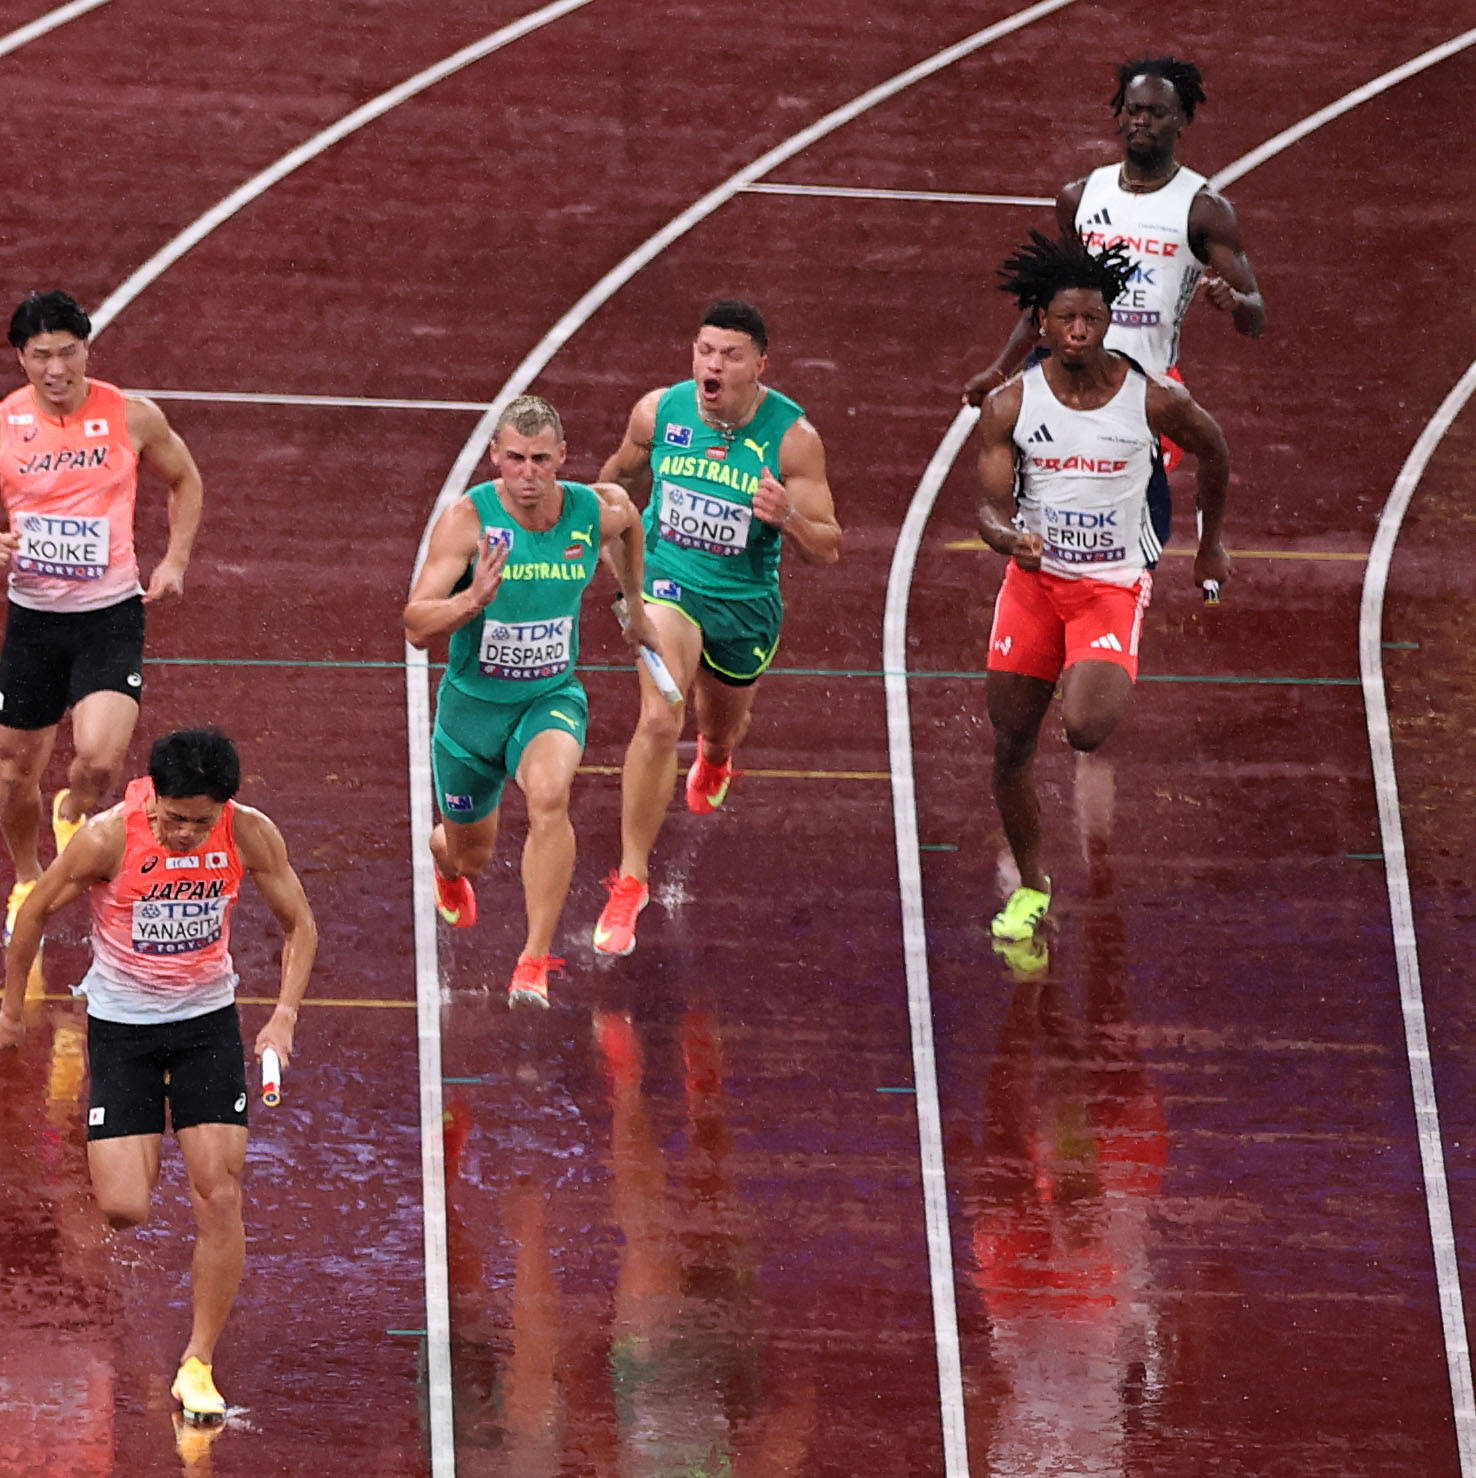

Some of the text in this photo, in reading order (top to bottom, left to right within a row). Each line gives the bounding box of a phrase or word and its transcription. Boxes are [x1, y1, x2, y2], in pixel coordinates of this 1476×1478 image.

[19, 447, 107, 474] JAPAN
[1033, 456, 1128, 473] FRANCE
[659, 456, 760, 494] AUSTRALIA
[686, 493, 744, 522] TDK
[41, 518, 100, 537] TDK
[670, 509, 736, 542] BOND
[1058, 510, 1117, 528] TDK
[1047, 526, 1114, 549] ERIUS
[27, 538, 97, 562] KOIKE
[502, 562, 586, 580] AUSTRALIA
[511, 621, 563, 641] TDK
[486, 642, 565, 665] DESPARD
[141, 880, 224, 901] JAPAN
[161, 899, 220, 918] TDK
